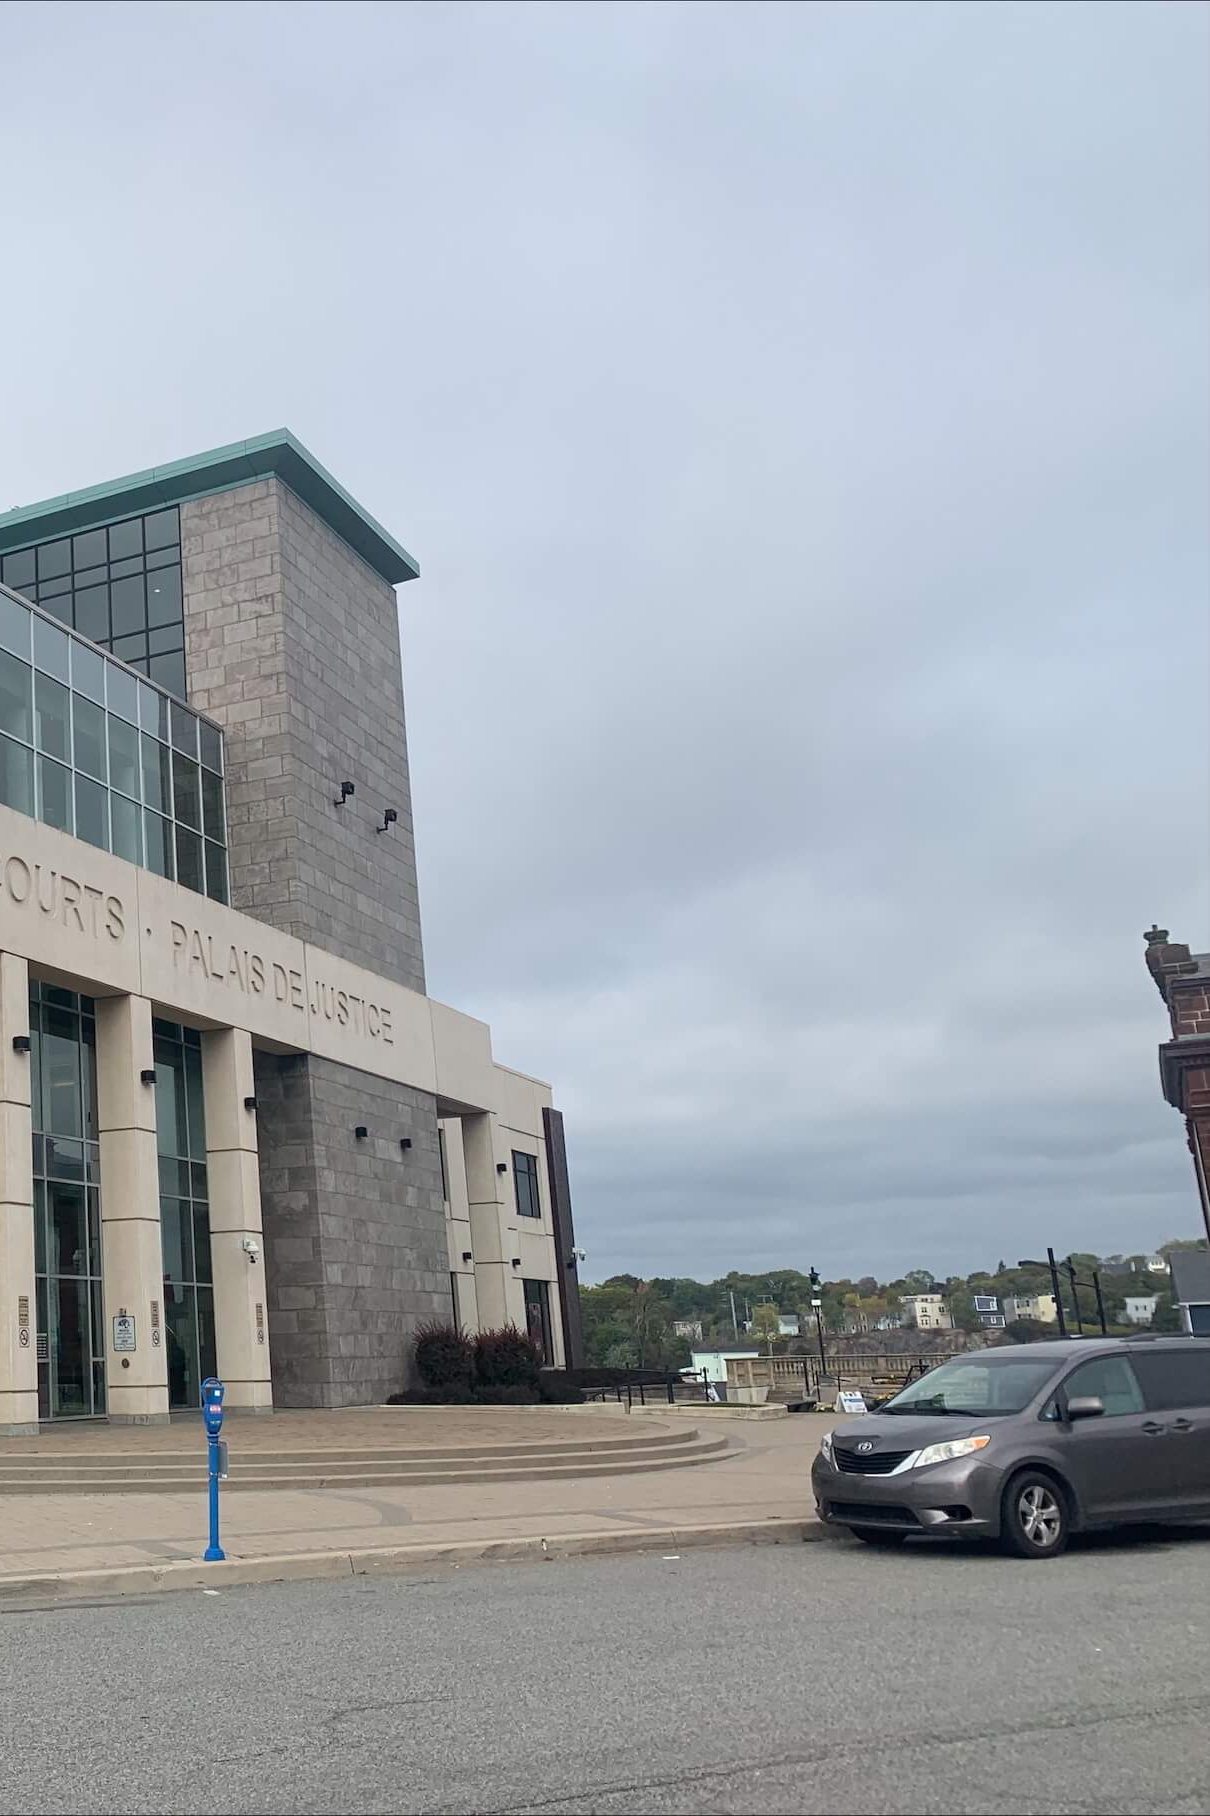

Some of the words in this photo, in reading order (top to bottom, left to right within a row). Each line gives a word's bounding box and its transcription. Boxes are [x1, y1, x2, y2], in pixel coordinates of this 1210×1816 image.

[170, 919, 265, 994] PALAIS
[273, 962, 304, 1009] DE
[309, 980, 394, 1044] JUSTICE
